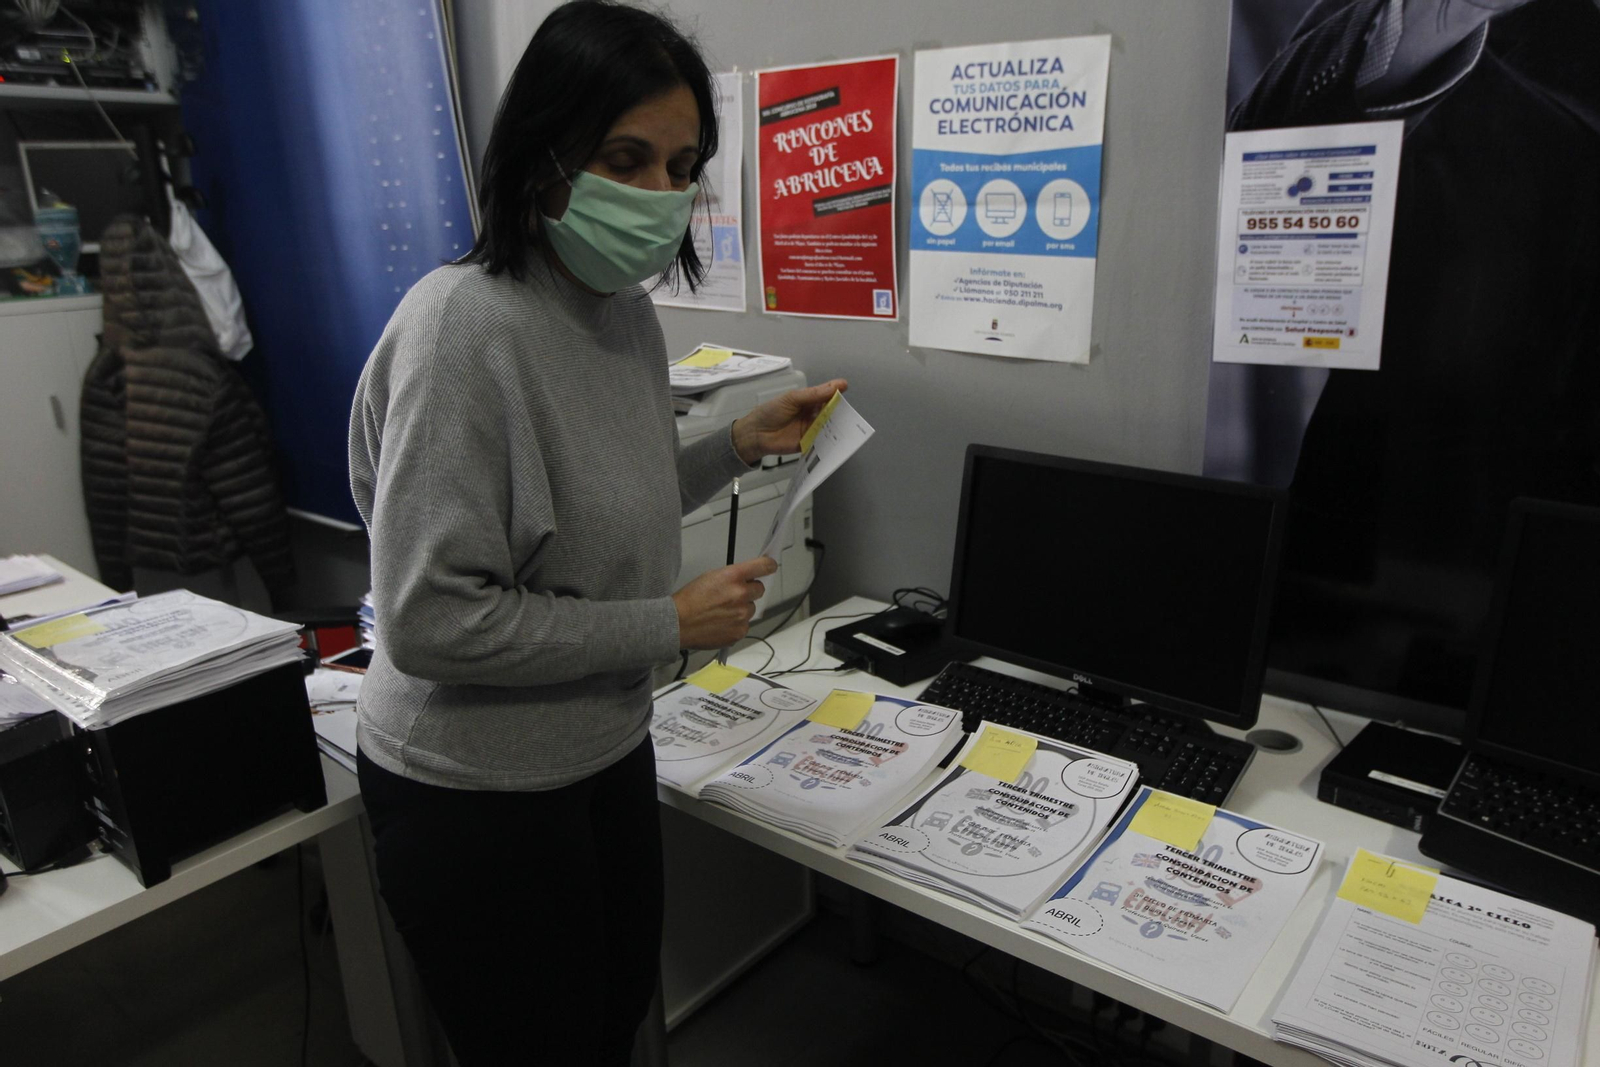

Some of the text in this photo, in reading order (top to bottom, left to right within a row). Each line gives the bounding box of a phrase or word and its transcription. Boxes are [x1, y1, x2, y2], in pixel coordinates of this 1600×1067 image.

[951, 57, 1064, 81] ACTUALIZA
[953, 79, 1061, 95] TUS DATOS PARA
[929, 87, 1087, 115] COMUNICACIÓN
[772, 109, 874, 154] RINCONES
[938, 112, 1074, 135] ELECTRÓNICA
[808, 142, 840, 167] DE
[940, 162, 1067, 173] Todos tus recibos municipales
[773, 156, 884, 200] ABRUCENA
[1246, 216, 1359, 230] 955 54 50 60
[937, 238, 956, 246] papel
[982, 240, 1015, 249] por email
[1046, 242, 1059, 250] por
[970, 267, 1026, 278] Infórmate en:
[959, 278, 1043, 289] Agencias de Diputación
[1004, 289, 1019, 297] 950
[1020, 290, 1032, 298] 211
[1033, 291, 1044, 299] 211
[1307, 327, 1344, 335] Responde
[1072, 673, 1093, 685] DELL
[830, 734, 890, 753] CONSOLIDACION
[839, 728, 905, 748] TERCER TRIMESTRE
[835, 742, 883, 758] CONTENIDOS
[728, 771, 756, 784] ABRIL
[988, 788, 1058, 815] CONSOLIDACION
[1058, 809, 1071, 819] DE
[998, 781, 1076, 811] TERCER TRIMESTRE
[995, 798, 1050, 820] CONTENIDOS
[879, 831, 911, 849] ABRIL
[1155, 852, 1254, 894] CONSOLIDACION DE
[1165, 845, 1257, 884] TERCER TRIMESTRE
[1166, 866, 1231, 895] CONTENIDOS
[1045, 907, 1082, 929] ABRIL
[1180, 909, 1218, 927] PRIMARIA
[1486, 911, 1531, 930] CICLO
[1460, 1041, 1499, 1060] REGULAR
